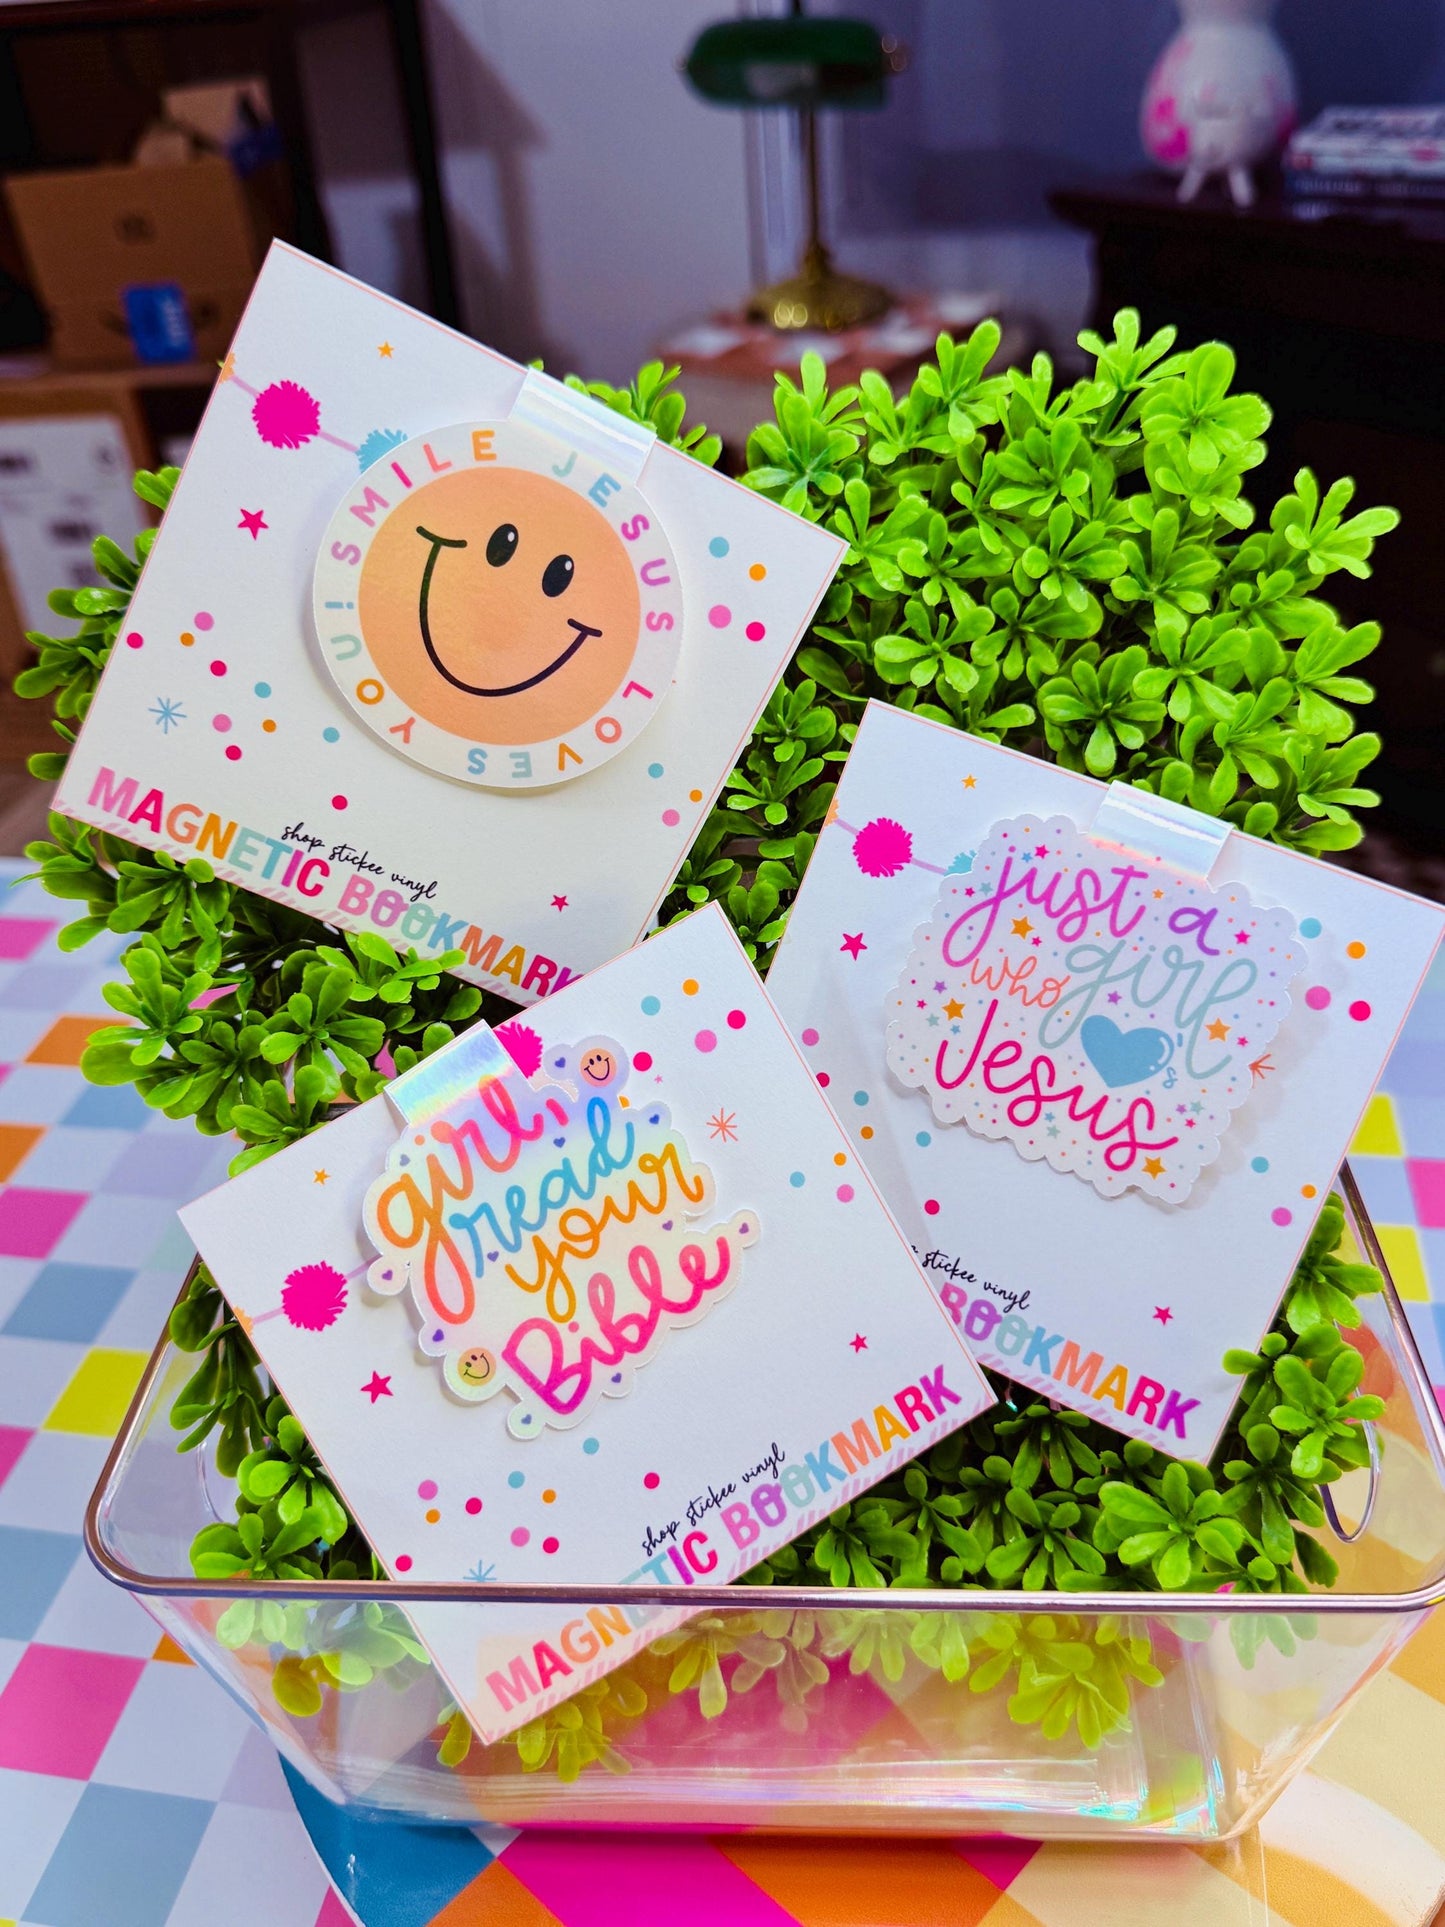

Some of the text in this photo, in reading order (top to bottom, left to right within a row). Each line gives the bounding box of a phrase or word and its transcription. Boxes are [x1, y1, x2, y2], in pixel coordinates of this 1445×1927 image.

[325, 430, 675, 778] SMILE JESUS LOVES YOU!
[87, 767, 330, 897] MAGNETIC
[281, 822, 439, 900] shop stickee vinyl
[942, 845, 1220, 968] just a
[935, 999, 1178, 1171] Jesus
[971, 939, 1258, 1080] who girl
[448, 1096, 635, 1279] read
[504, 1143, 704, 1323] your
[501, 1236, 731, 1416] Bible
[922, 1249, 1031, 1313] stickee vinyl
[940, 1282, 1201, 1439] BOOKMARK
[640, 1442, 787, 1557] shop stickee vinyl
[720, 1364, 963, 1551] BOOKMARK
